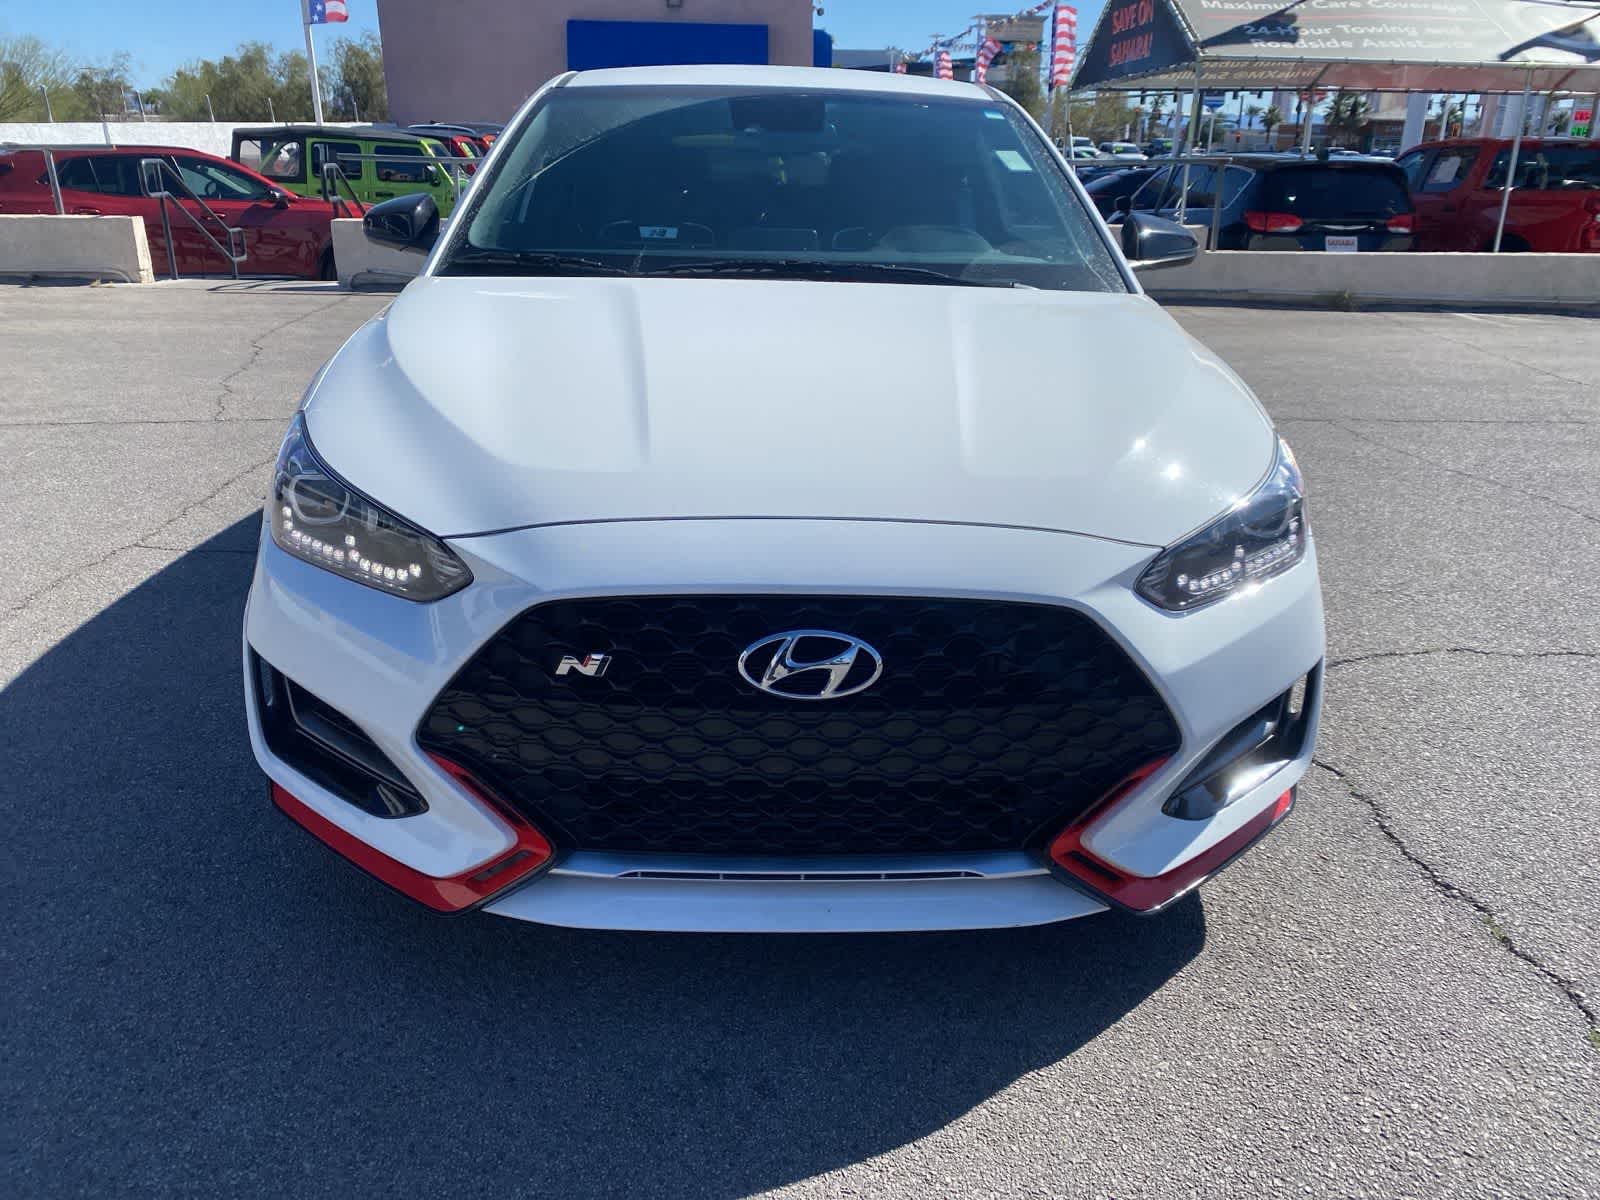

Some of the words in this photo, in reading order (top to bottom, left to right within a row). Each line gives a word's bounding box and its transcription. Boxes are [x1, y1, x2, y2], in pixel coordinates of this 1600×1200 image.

[1312, 0, 1361, 9] Care
[1112, 4, 1137, 35] SAVE
[1137, 0, 1153, 26] ON
[1243, 25, 1333, 37] 24-Hour
[1336, 23, 1419, 37] Towing
[1110, 31, 1153, 67] SAHARA!
[1249, 38, 1353, 49] Roadside
[1362, 38, 1473, 49] Assist
